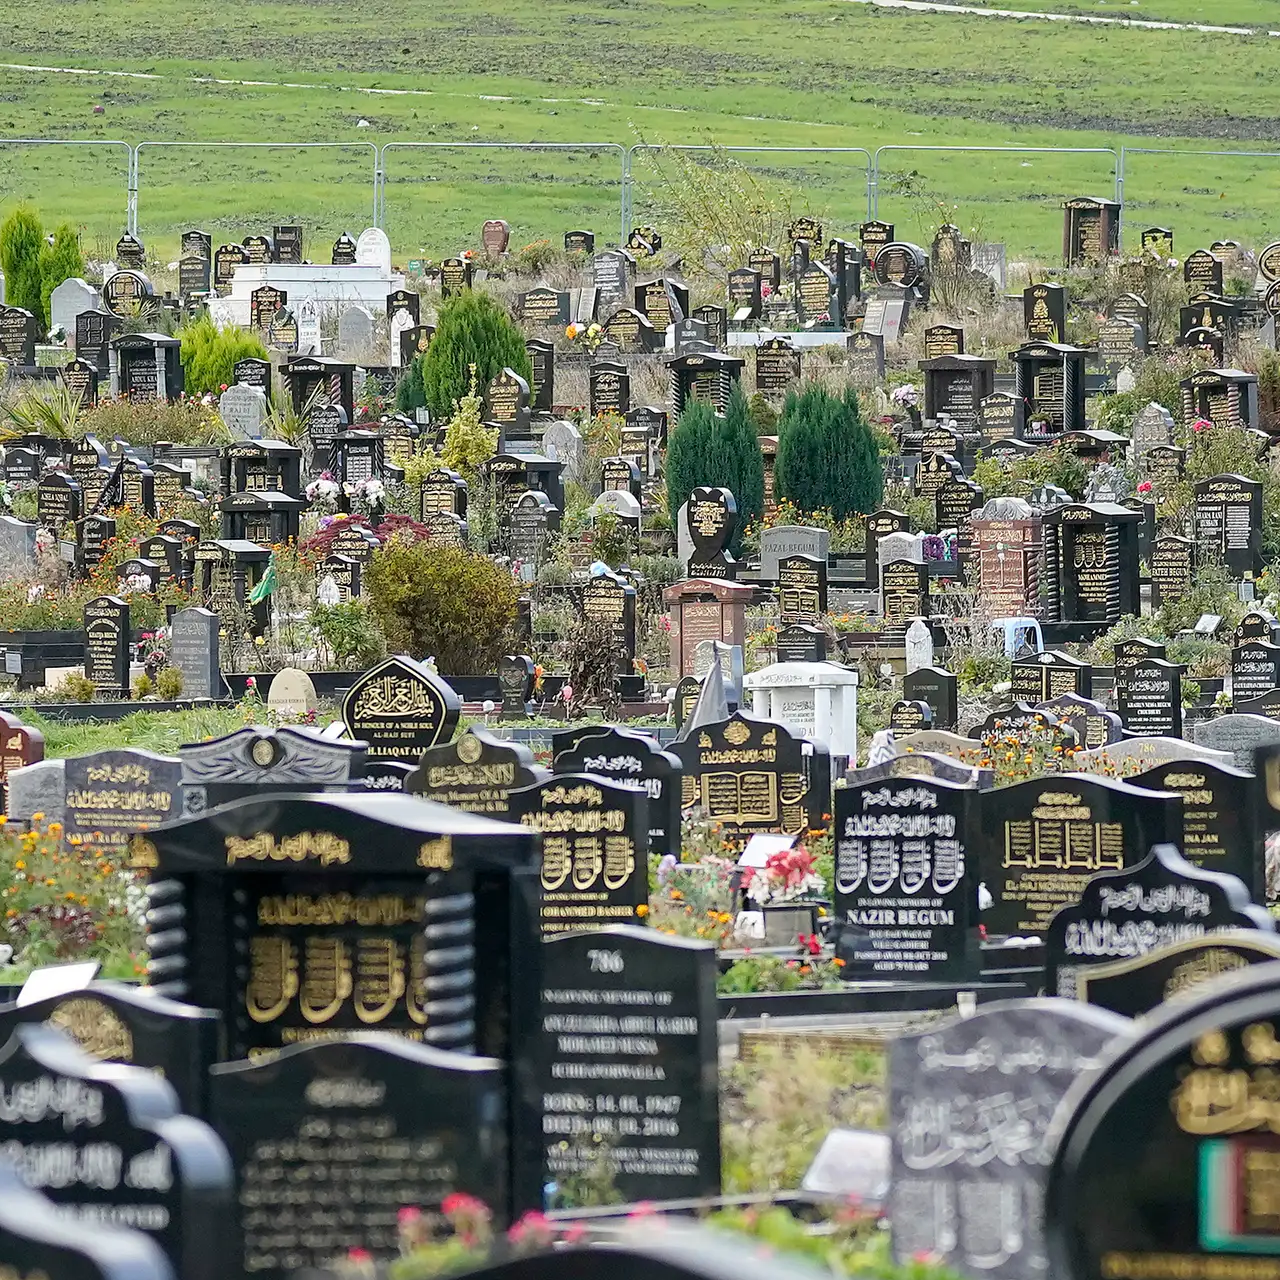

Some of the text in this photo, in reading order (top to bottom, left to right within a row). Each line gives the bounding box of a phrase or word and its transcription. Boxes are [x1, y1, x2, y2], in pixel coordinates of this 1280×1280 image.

[764, 544, 815, 553] FAZAL BEGUM
[377, 748, 409, 757] LIAQAT
[1139, 744, 1157, 753] 786
[540, 906, 597, 918] OHAMMED
[847, 910, 956, 927] NAZIR BEGUM
[587, 949, 625, 973] 786
